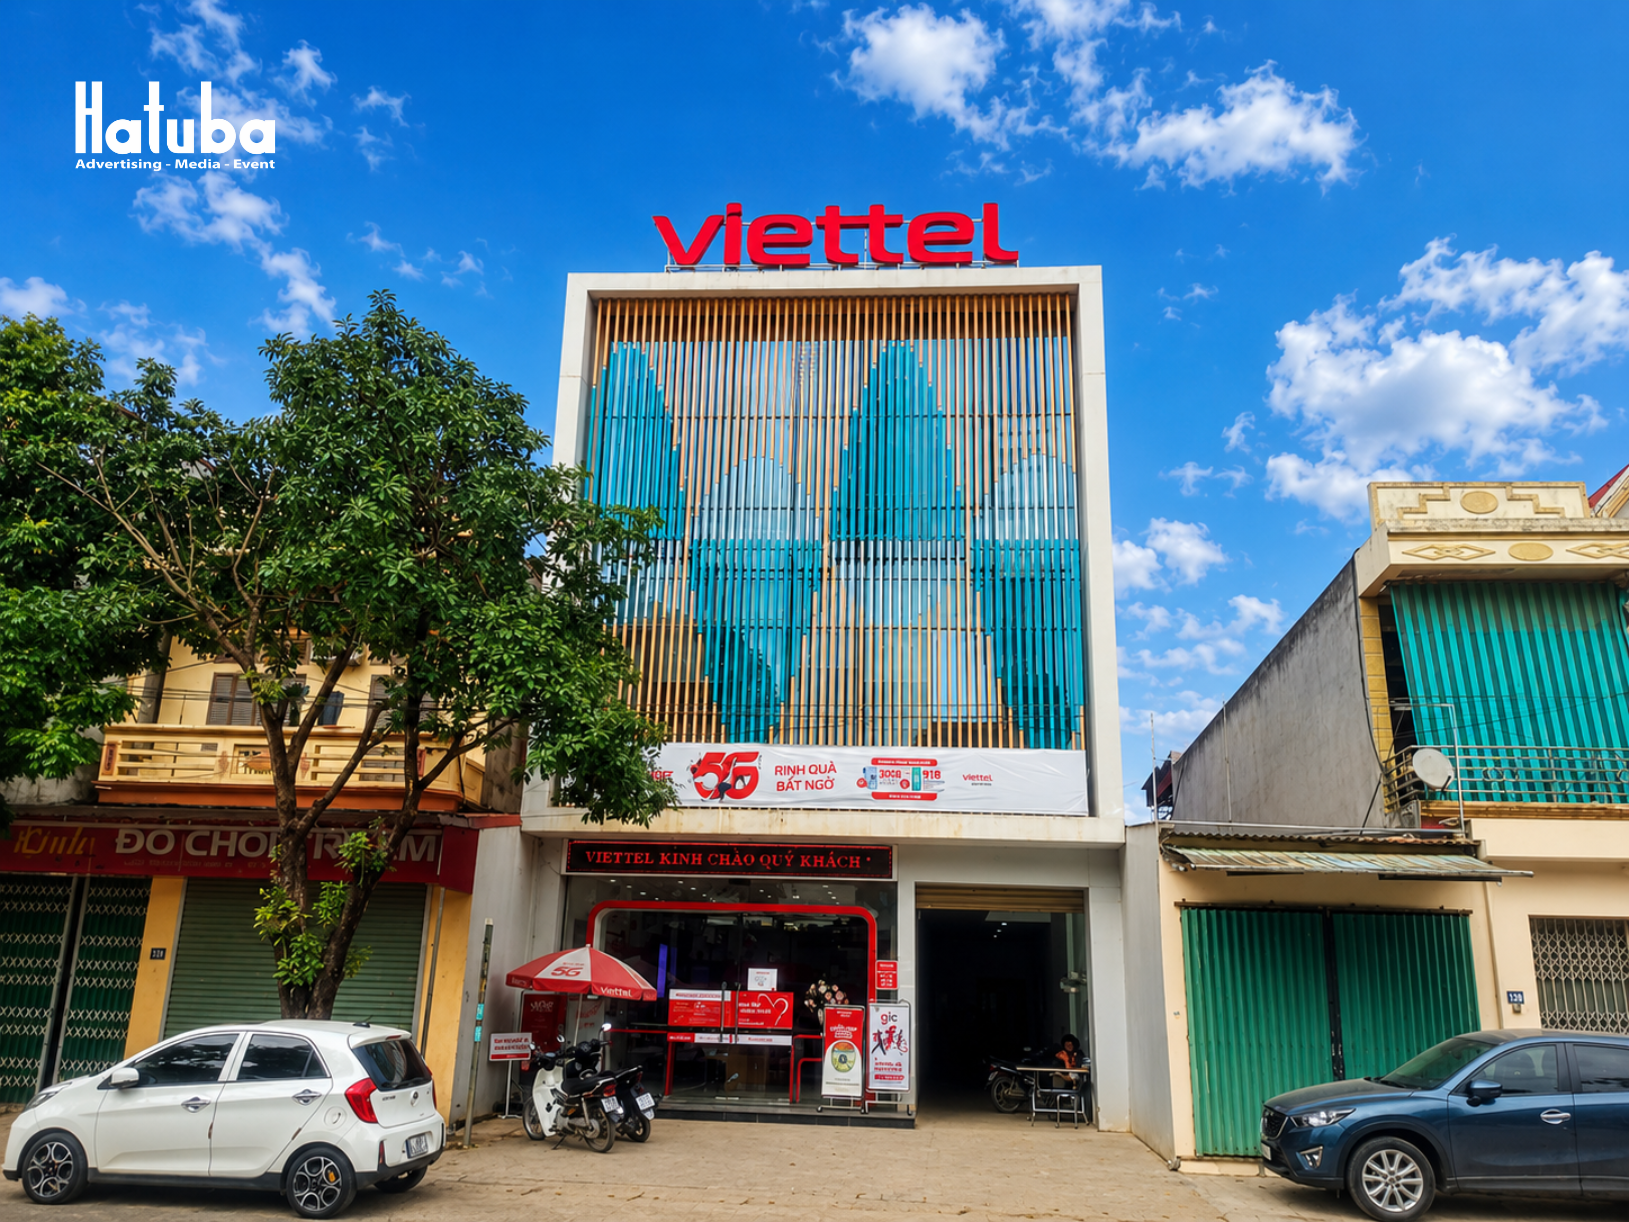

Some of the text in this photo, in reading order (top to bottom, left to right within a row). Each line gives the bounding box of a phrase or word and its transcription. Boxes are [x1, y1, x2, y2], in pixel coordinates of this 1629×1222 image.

[652, 203, 1019, 267] viettel
[774, 760, 838, 777] RINH QUÀ
[804, 775, 836, 791] NGỜ
[585, 851, 654, 864] VIETTEL
[707, 847, 755, 866] CHÀO
[759, 850, 795, 870] QUÝ
[800, 851, 861, 869] KHÁCH
[551, 966, 584, 977] 5G
